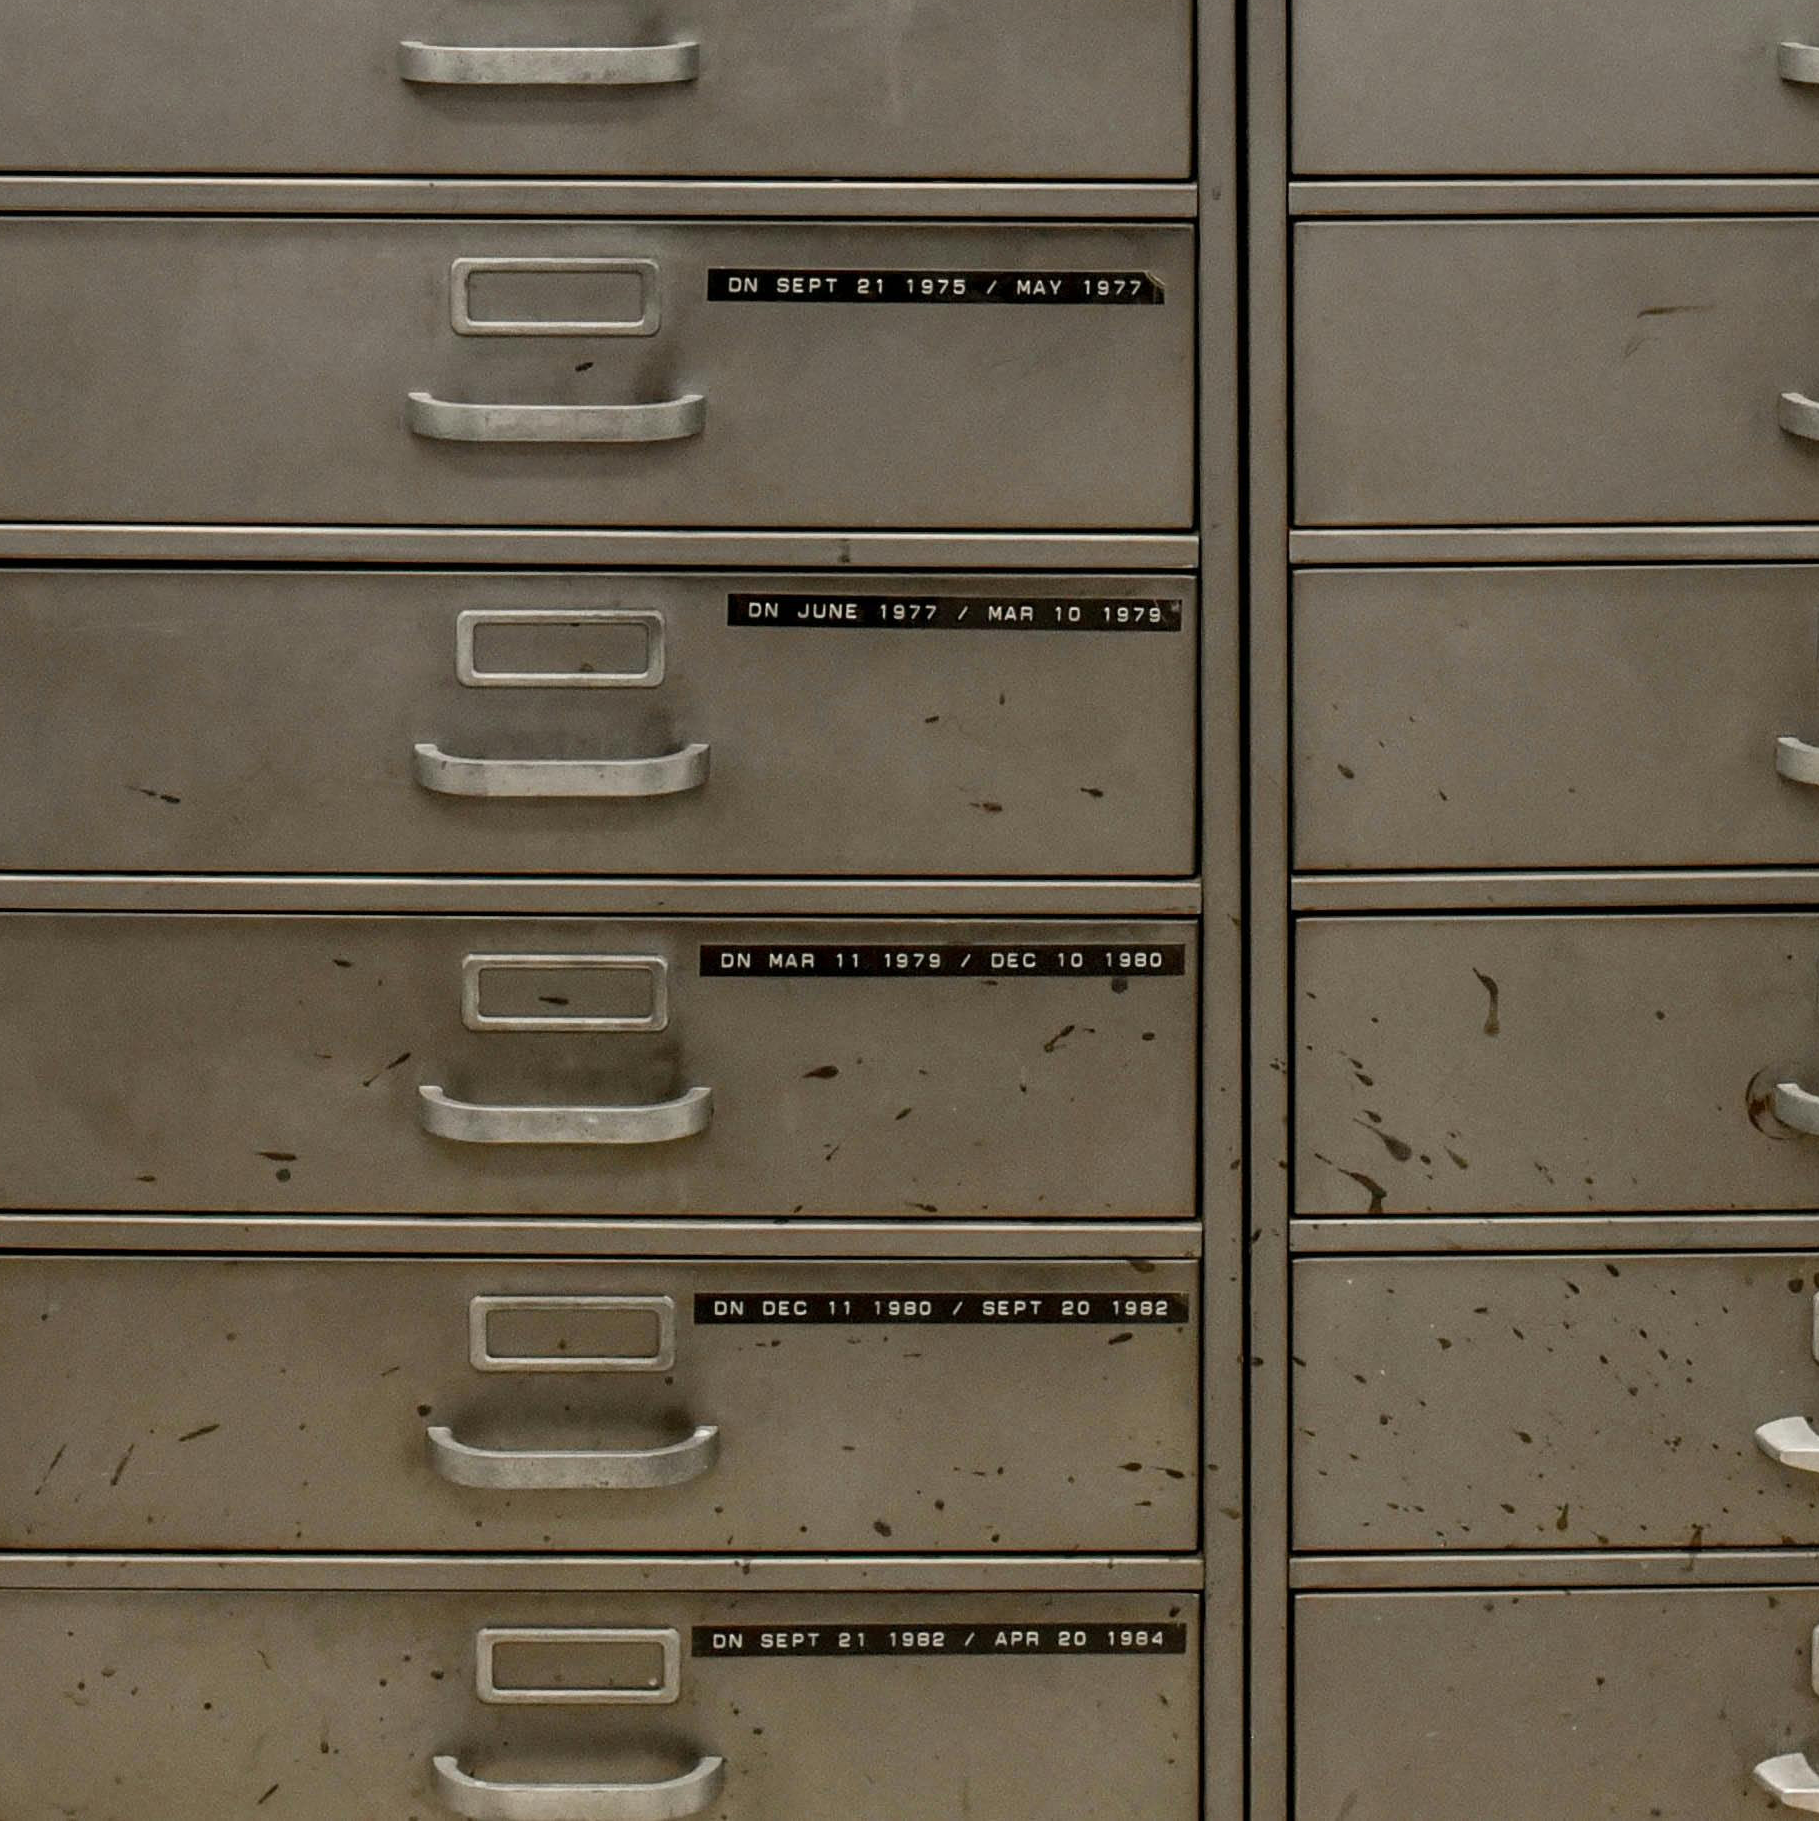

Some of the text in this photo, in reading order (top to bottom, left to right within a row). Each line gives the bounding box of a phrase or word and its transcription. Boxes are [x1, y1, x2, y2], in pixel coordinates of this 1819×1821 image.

[728, 276, 758, 293] DN
[776, 276, 838, 293] SEPT
[857, 278, 883, 295] 21
[906, 278, 966, 295] 1975
[1016, 279, 1062, 296] MAY
[1084, 279, 1142, 296] 1977
[748, 601, 779, 618] DN
[797, 603, 857, 620] JUNE
[880, 604, 937, 621] 1977
[988, 605, 1034, 621] MAR
[1055, 605, 1081, 623] 10
[1103, 606, 1161, 623] 1979
[712, 1633, 743, 1649] DN
[760, 1632, 820, 1649] SEPT
[838, 1632, 864, 1648] 21
[889, 1631, 945, 1648] 1982
[994, 1630, 1039, 1646] APR
[1058, 1630, 1087, 1647] 20
[1108, 1630, 1163, 1647] 1984
